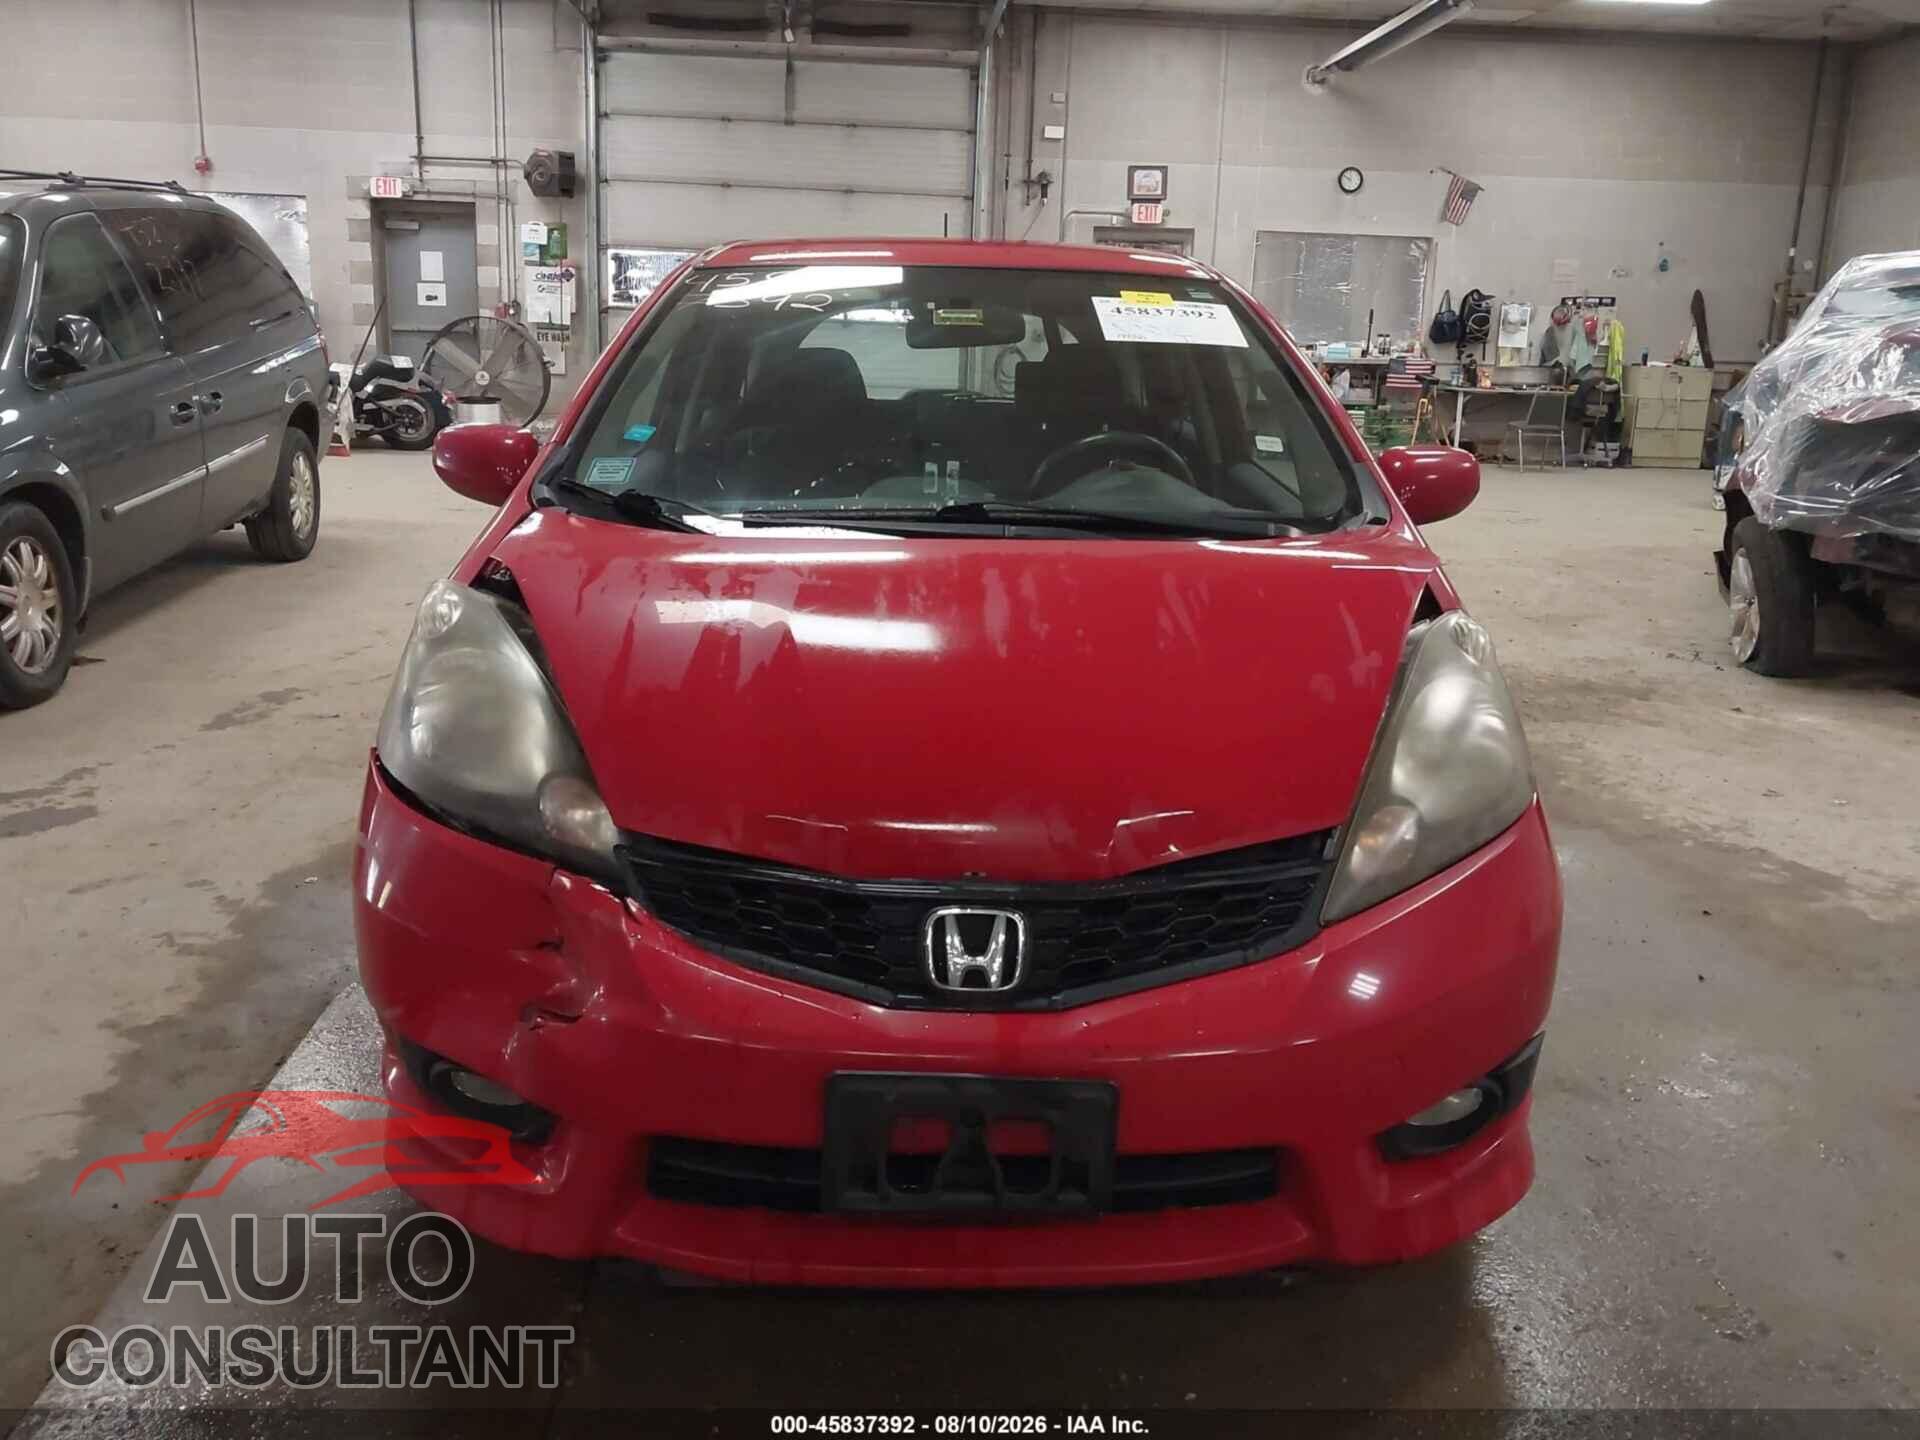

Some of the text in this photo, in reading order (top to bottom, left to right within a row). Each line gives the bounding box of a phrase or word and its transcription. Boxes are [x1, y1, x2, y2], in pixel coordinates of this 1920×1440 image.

[375, 177, 399, 196] EXIT
[1137, 203, 1160, 222] EXIT
[1110, 306, 1217, 320] 45837392
[536, 331, 550, 342] EYE
